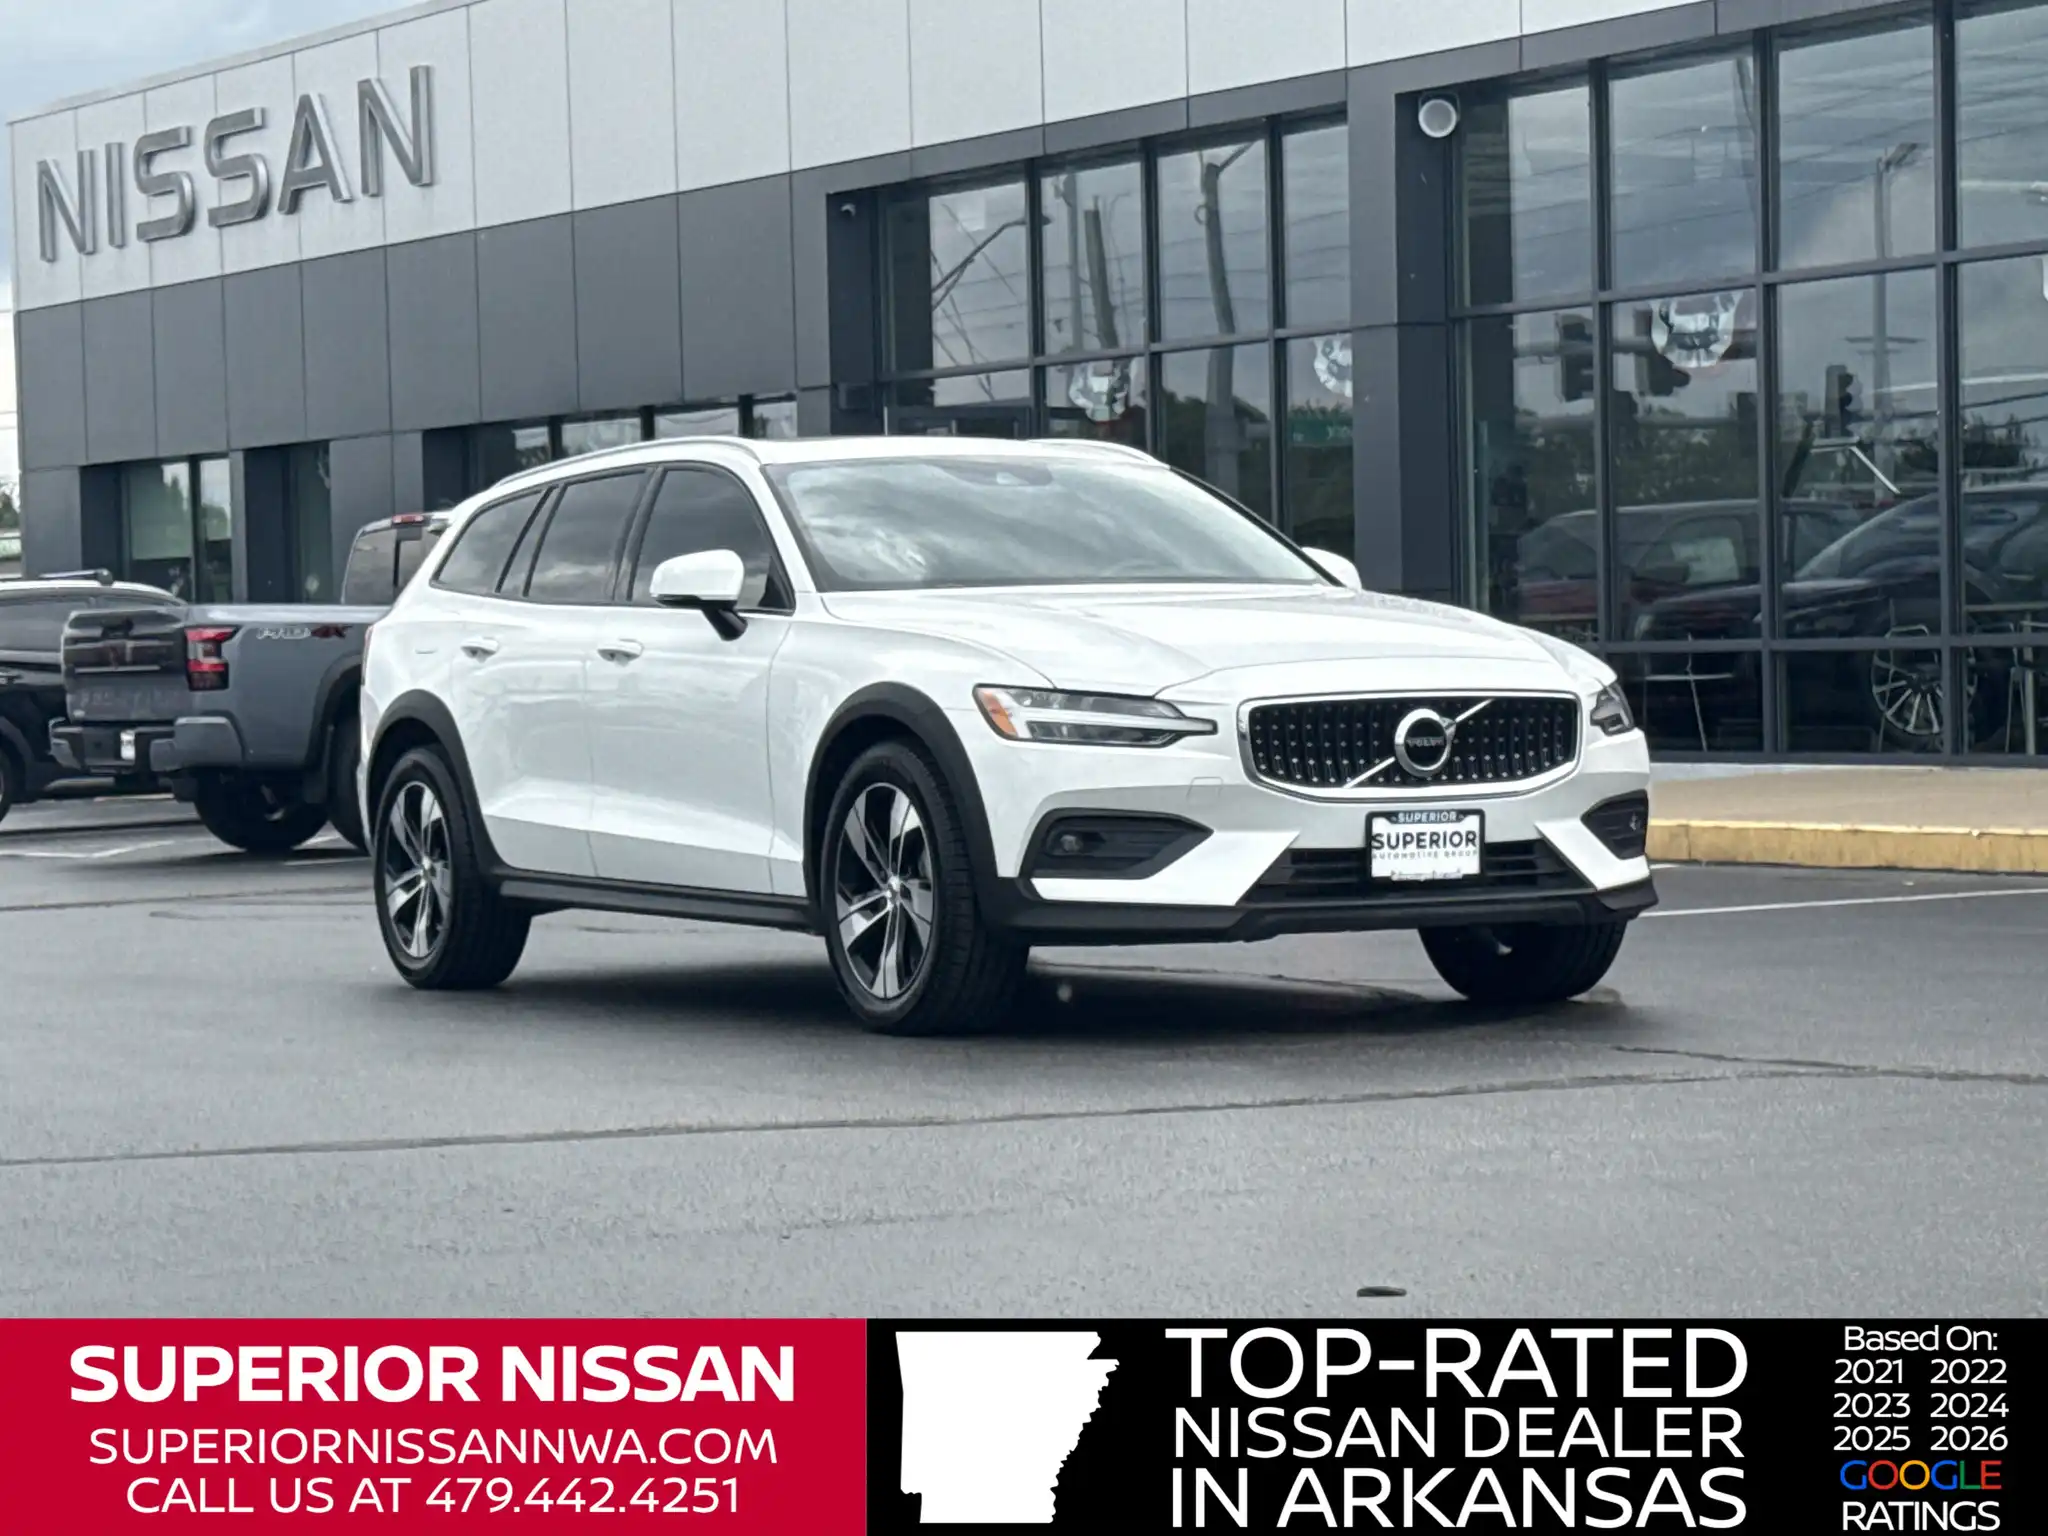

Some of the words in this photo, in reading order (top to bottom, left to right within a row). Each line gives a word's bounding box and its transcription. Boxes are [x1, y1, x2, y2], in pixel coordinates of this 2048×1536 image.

[36, 64, 433, 262] NISSAN
[1397, 811, 1457, 824] SUPERIOR
[1372, 830, 1477, 850] SUPERIOR
